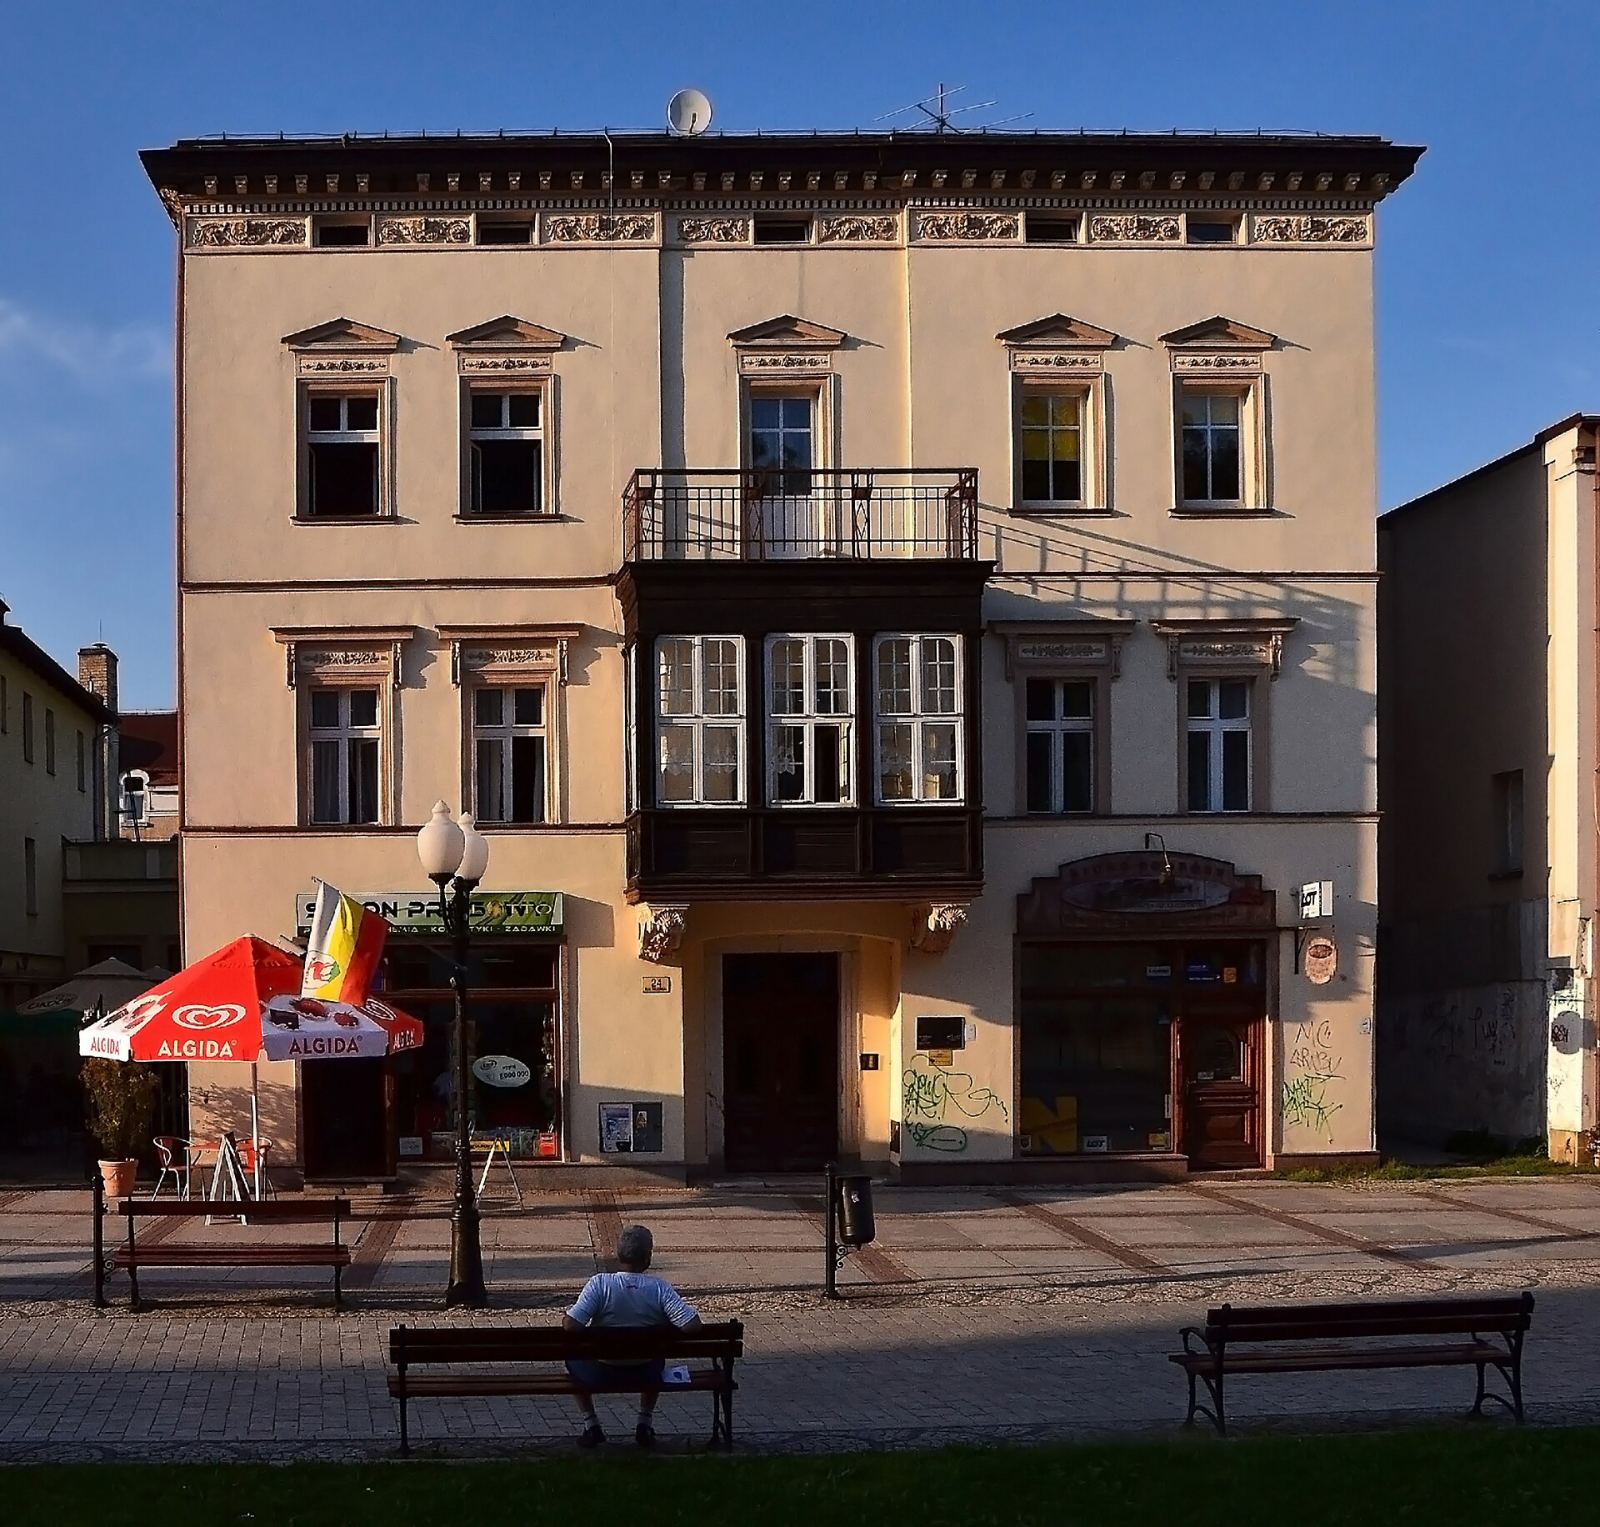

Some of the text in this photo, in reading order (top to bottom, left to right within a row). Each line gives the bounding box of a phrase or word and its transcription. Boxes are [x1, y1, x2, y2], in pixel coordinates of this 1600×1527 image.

[1301, 891, 1317, 907] LOT
[305, 901, 398, 918] SON
[91, 1037, 119, 1055] ALGIDA
[158, 1040, 232, 1058] ALGIDA
[289, 1037, 358, 1055] ALGIDA
